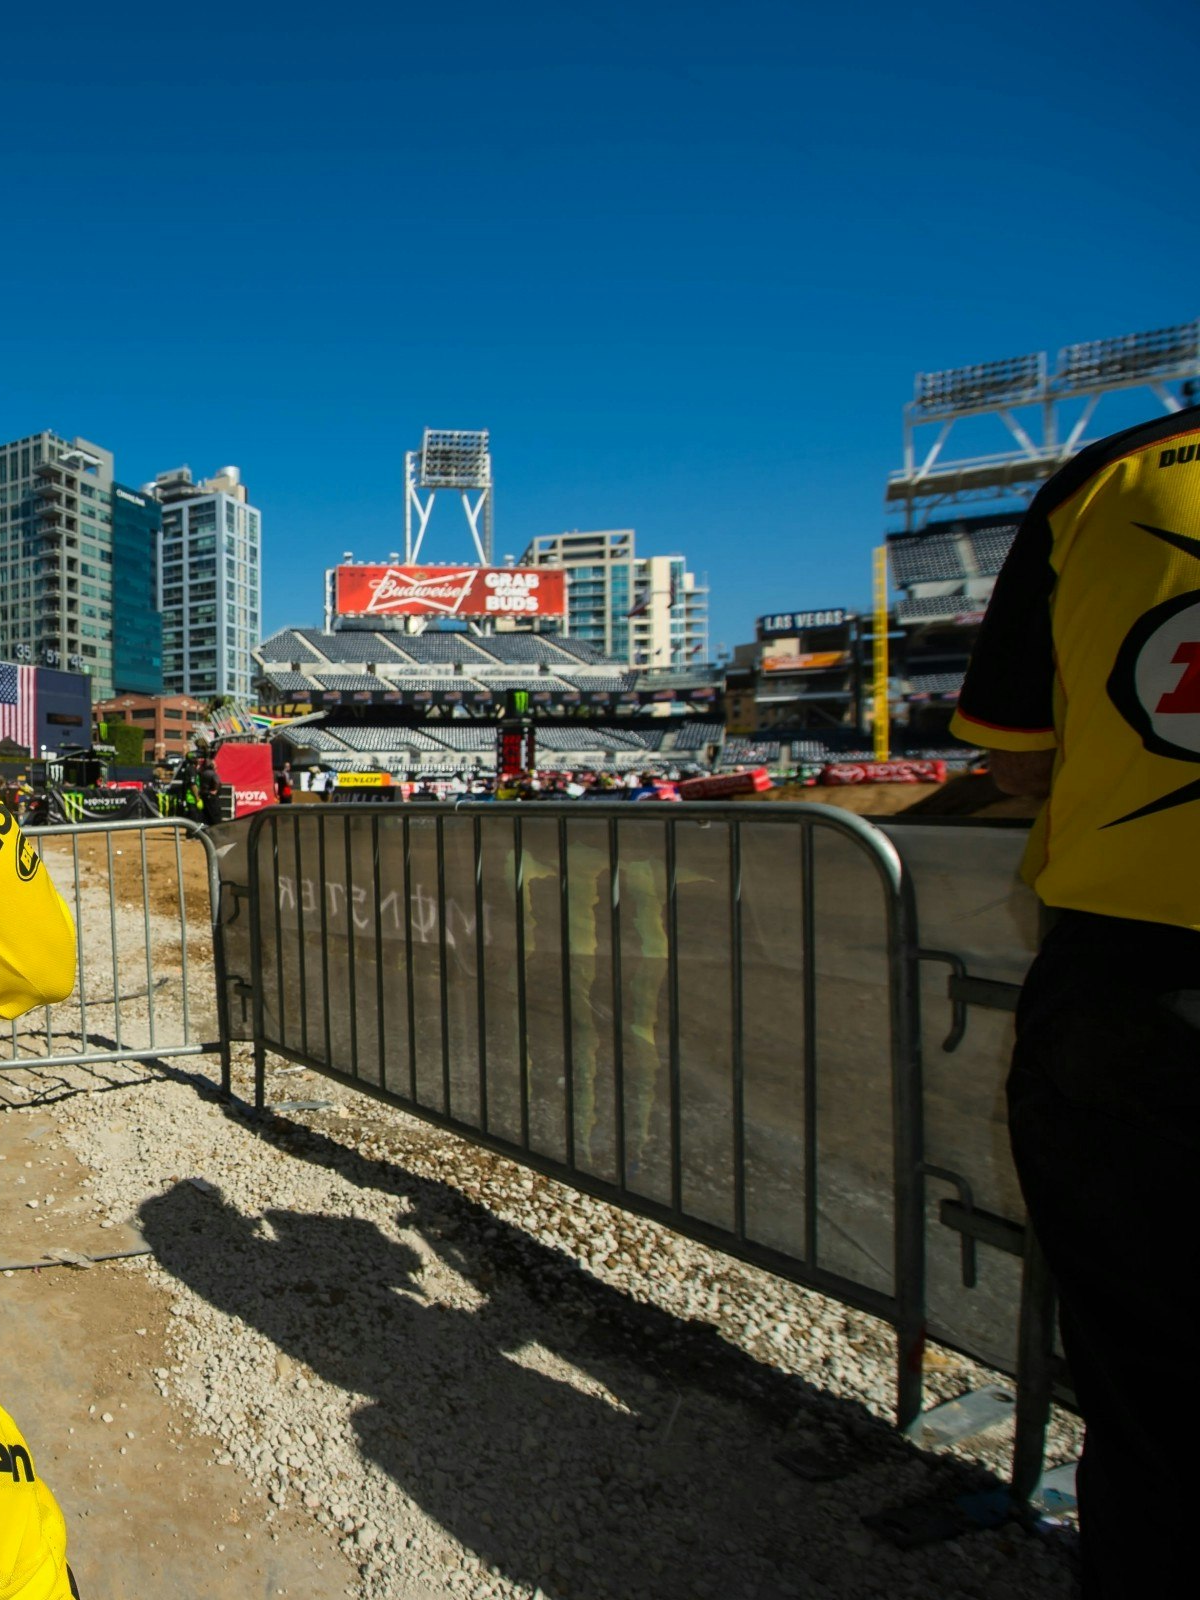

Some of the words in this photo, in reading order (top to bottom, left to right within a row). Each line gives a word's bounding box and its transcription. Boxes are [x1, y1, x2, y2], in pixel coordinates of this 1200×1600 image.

[484, 572, 540, 589] GRAB
[378, 577, 473, 601] Budweiser
[485, 596, 539, 612] BUDS
[764, 614, 792, 632] LAS
[796, 609, 844, 629] VEGAS
[16, 643, 32, 659] 35
[339, 776, 381, 784] DUNLOP
